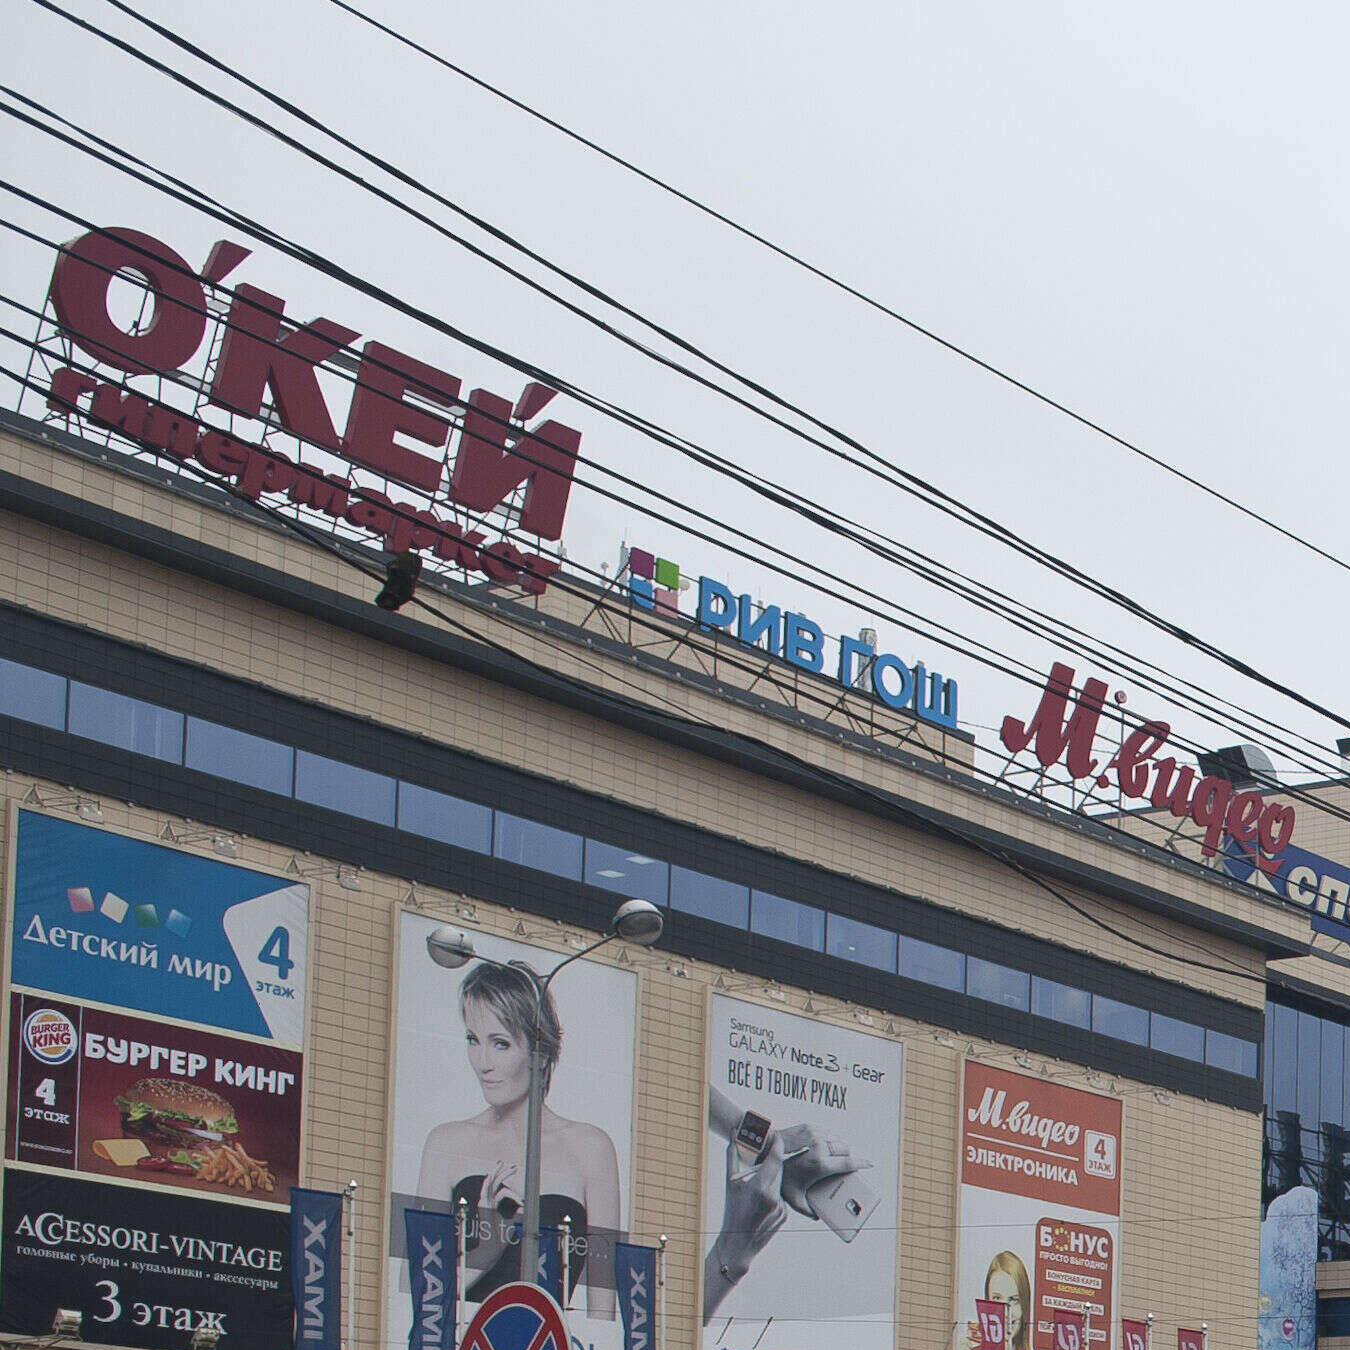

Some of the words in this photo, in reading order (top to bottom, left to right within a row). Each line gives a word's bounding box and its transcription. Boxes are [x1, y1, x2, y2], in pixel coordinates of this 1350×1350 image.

[698, 575, 824, 674] РИВ
[840, 634, 957, 728] ГОШ
[23, 914, 159, 969] Детский
[168, 953, 232, 992] мир
[257, 926, 294, 980] 4
[256, 980, 295, 1000] этаж
[31, 1022, 69, 1036] BURGER
[32, 1032, 71, 1048] KING
[729, 1017, 774, 1041] Samsung
[85, 1032, 207, 1078] БУРГЕР
[215, 1059, 295, 1095] КИНГ
[728, 1032, 788, 1060] GALAXY
[791, 1048, 823, 1069] Note
[824, 1054, 840, 1072] 3
[853, 1063, 885, 1083] Gear
[35, 1078, 56, 1106] 4
[755, 1066, 763, 1090] В
[768, 1068, 807, 1101] ТВОИХ
[811, 1079, 847, 1110] РУКАХ
[24, 1107, 70, 1125] этаж
[967, 1087, 1080, 1148] М.видео
[966, 1145, 1079, 1186] ЭЛЕКТРОНИКА
[1094, 1138, 1107, 1161] 4
[16, 1245, 77, 1262] головные
[80, 1252, 119, 1268] уборы
[131, 1261, 202, 1278] купальники
[213, 1272, 278, 1290] аксессуары
[93, 1279, 121, 1322] 3
[132, 1302, 228, 1335] этаж
